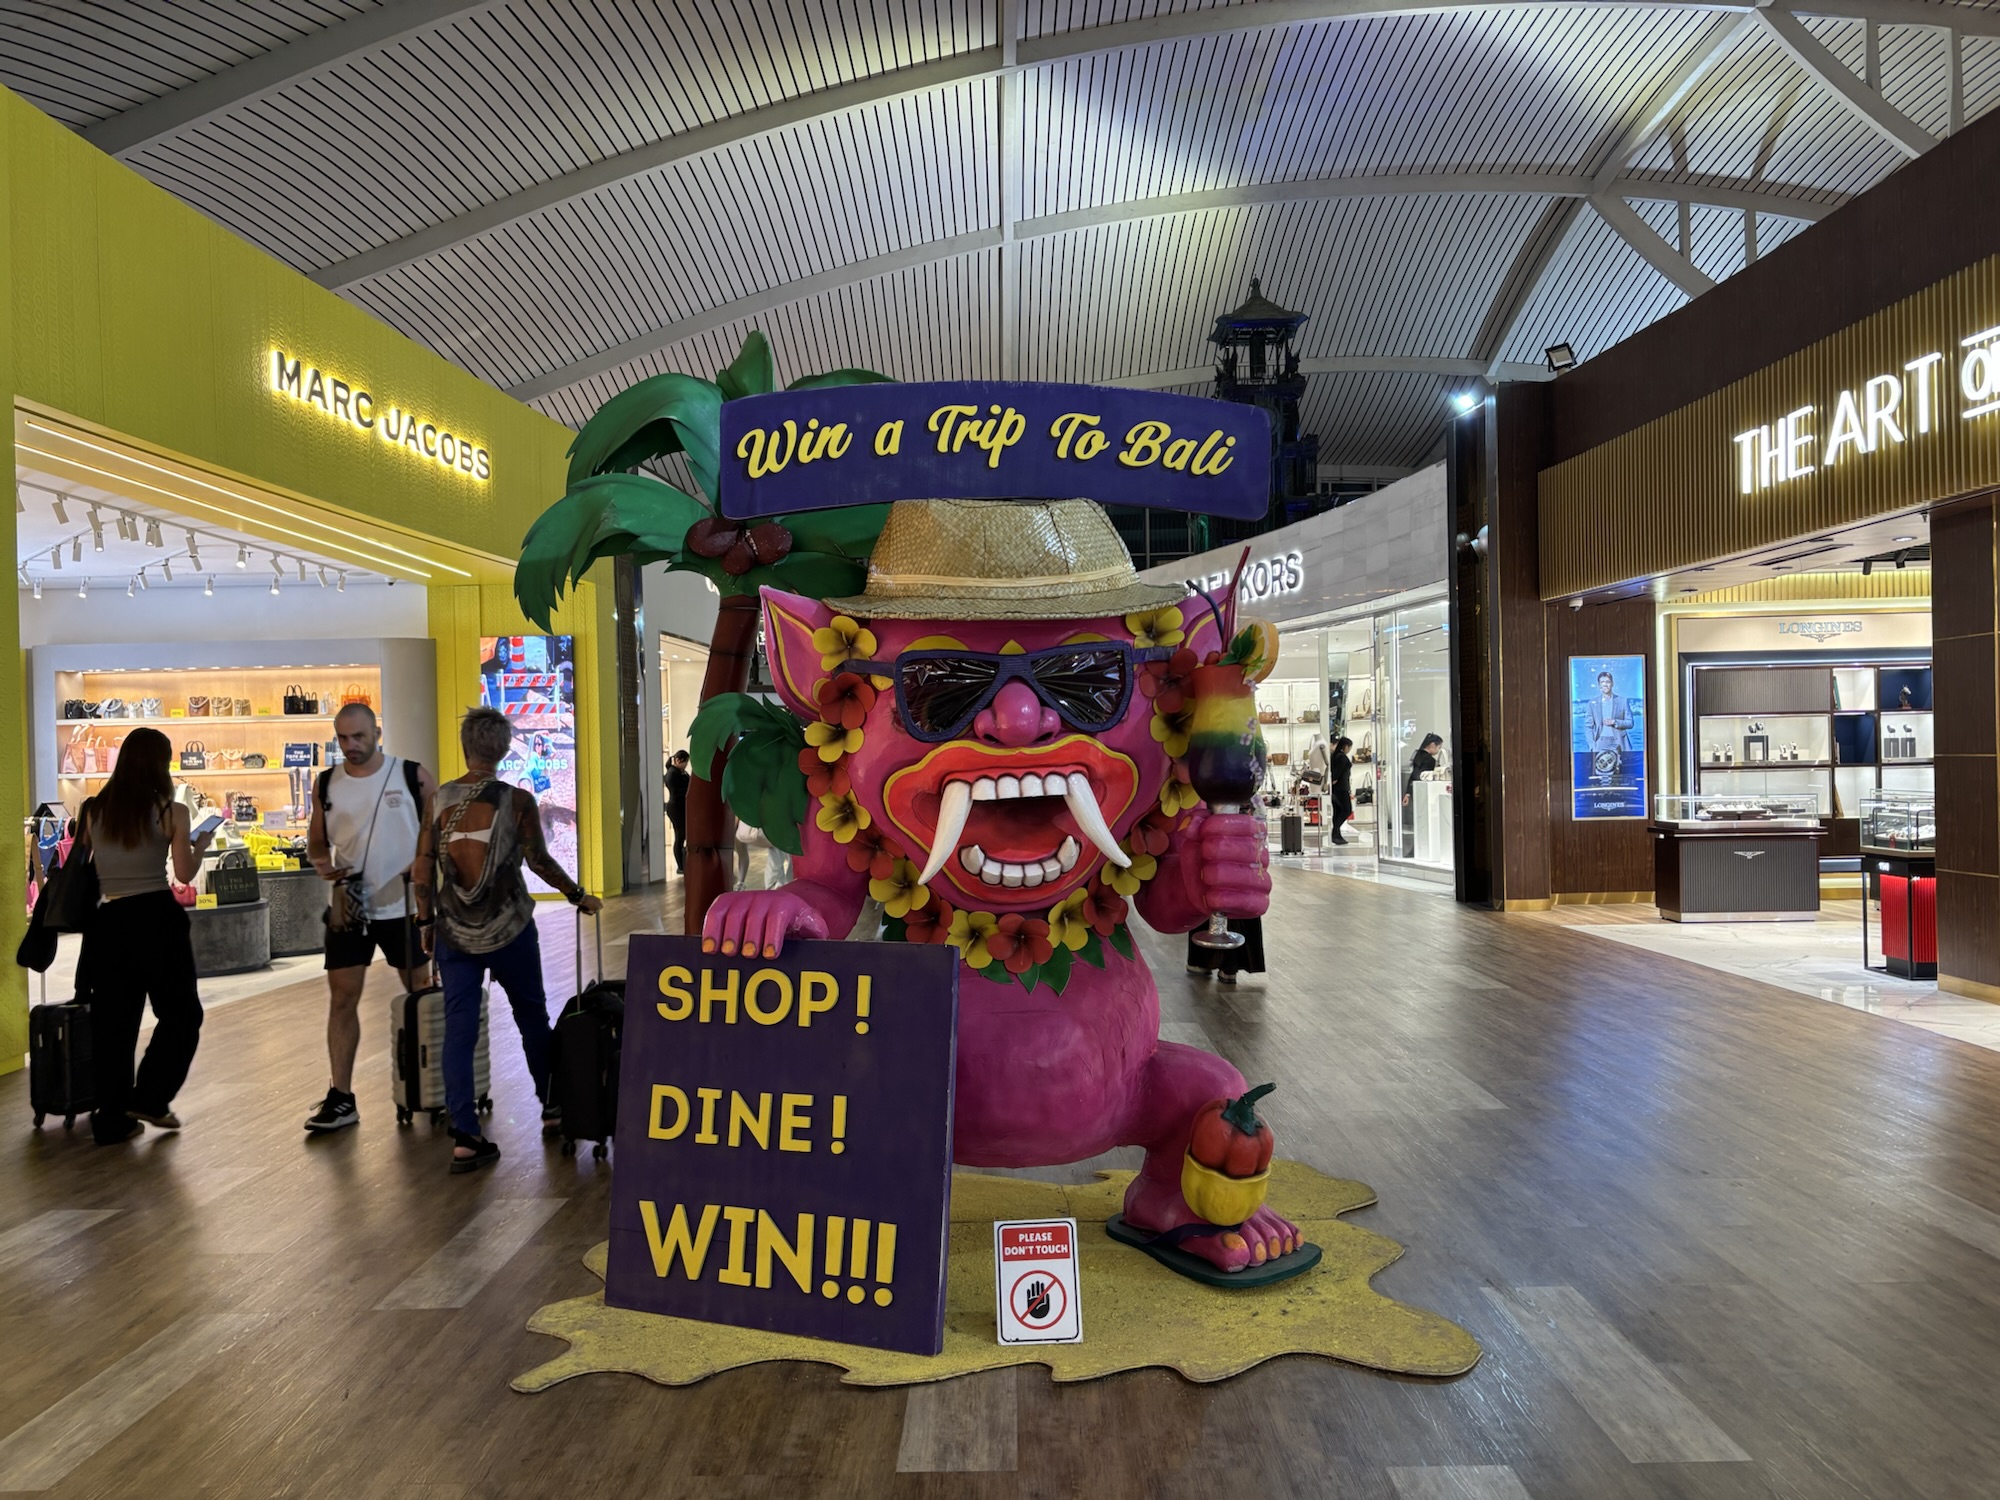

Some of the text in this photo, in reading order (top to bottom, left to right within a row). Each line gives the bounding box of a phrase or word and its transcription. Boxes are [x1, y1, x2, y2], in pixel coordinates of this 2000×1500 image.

[273, 351, 490, 480] MARC JACOBS
[1733, 405, 1815, 494] THE
[1824, 352, 1943, 465] ART
[738, 404, 1237, 478] Win a Trip To Bali
[1239, 552, 1303, 601] KORS
[1778, 621, 1863, 634] LONGINES
[498, 760, 521, 771] ARC
[1004, 1244, 1068, 1256] DON'T TOUCH
[1018, 1231, 1053, 1243] PLEASE
